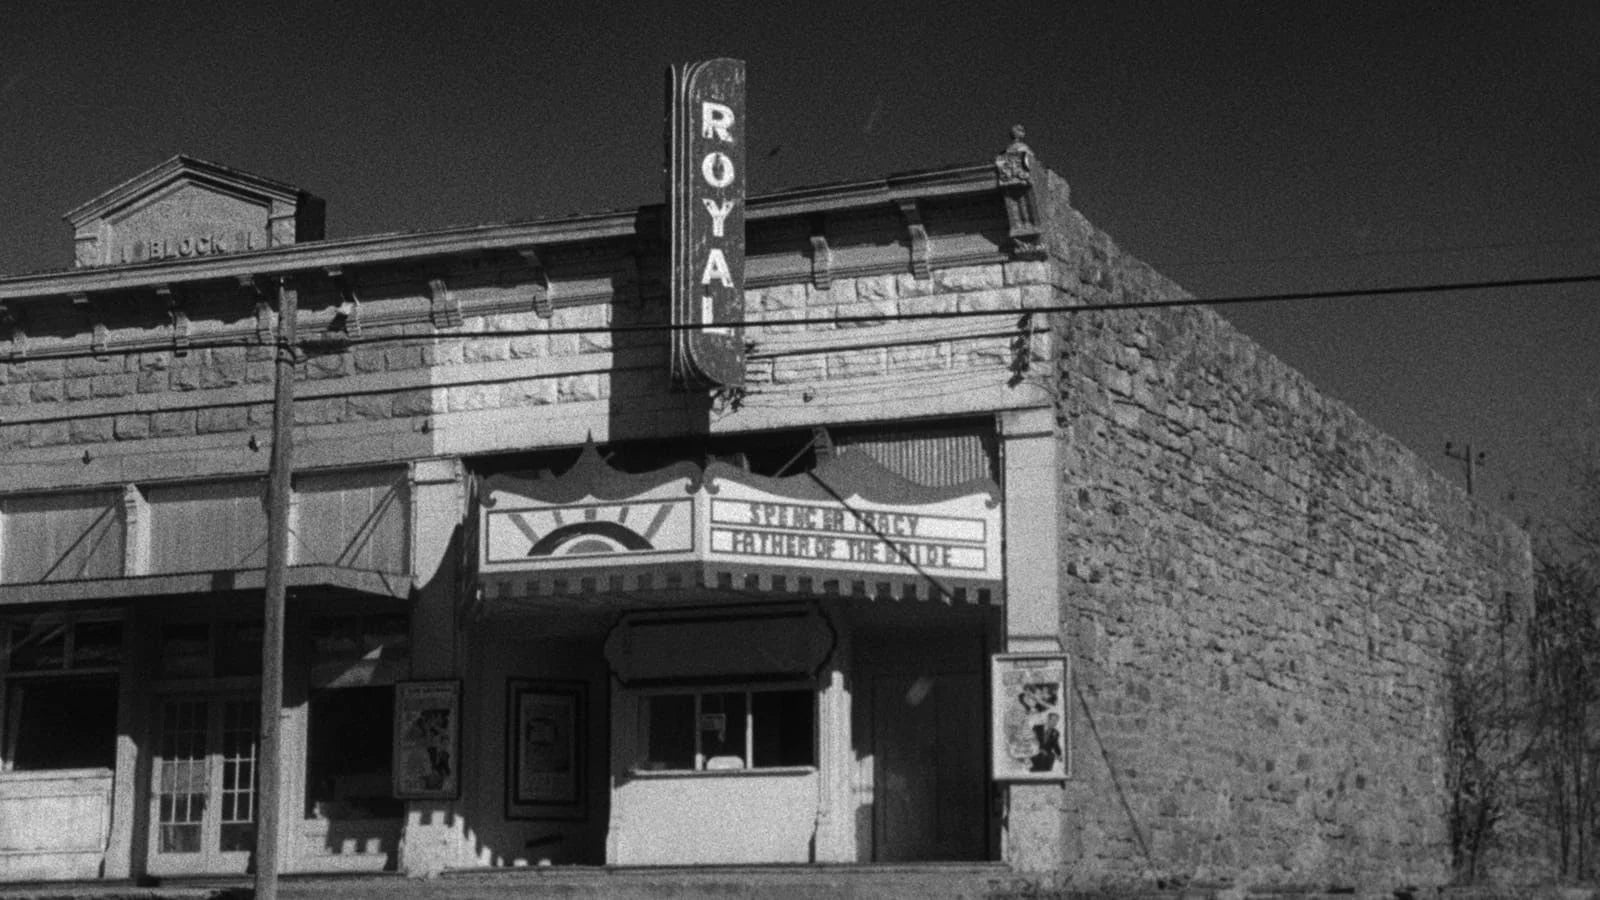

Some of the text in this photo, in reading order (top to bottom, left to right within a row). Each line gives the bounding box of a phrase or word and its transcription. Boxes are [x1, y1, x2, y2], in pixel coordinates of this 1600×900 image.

[701, 100, 736, 337] ROYAL
[149, 232, 226, 259] BLOCK
[749, 503, 920, 537] SPENCER TRACY
[731, 530, 953, 569] FATHER OF THE BRIDE
